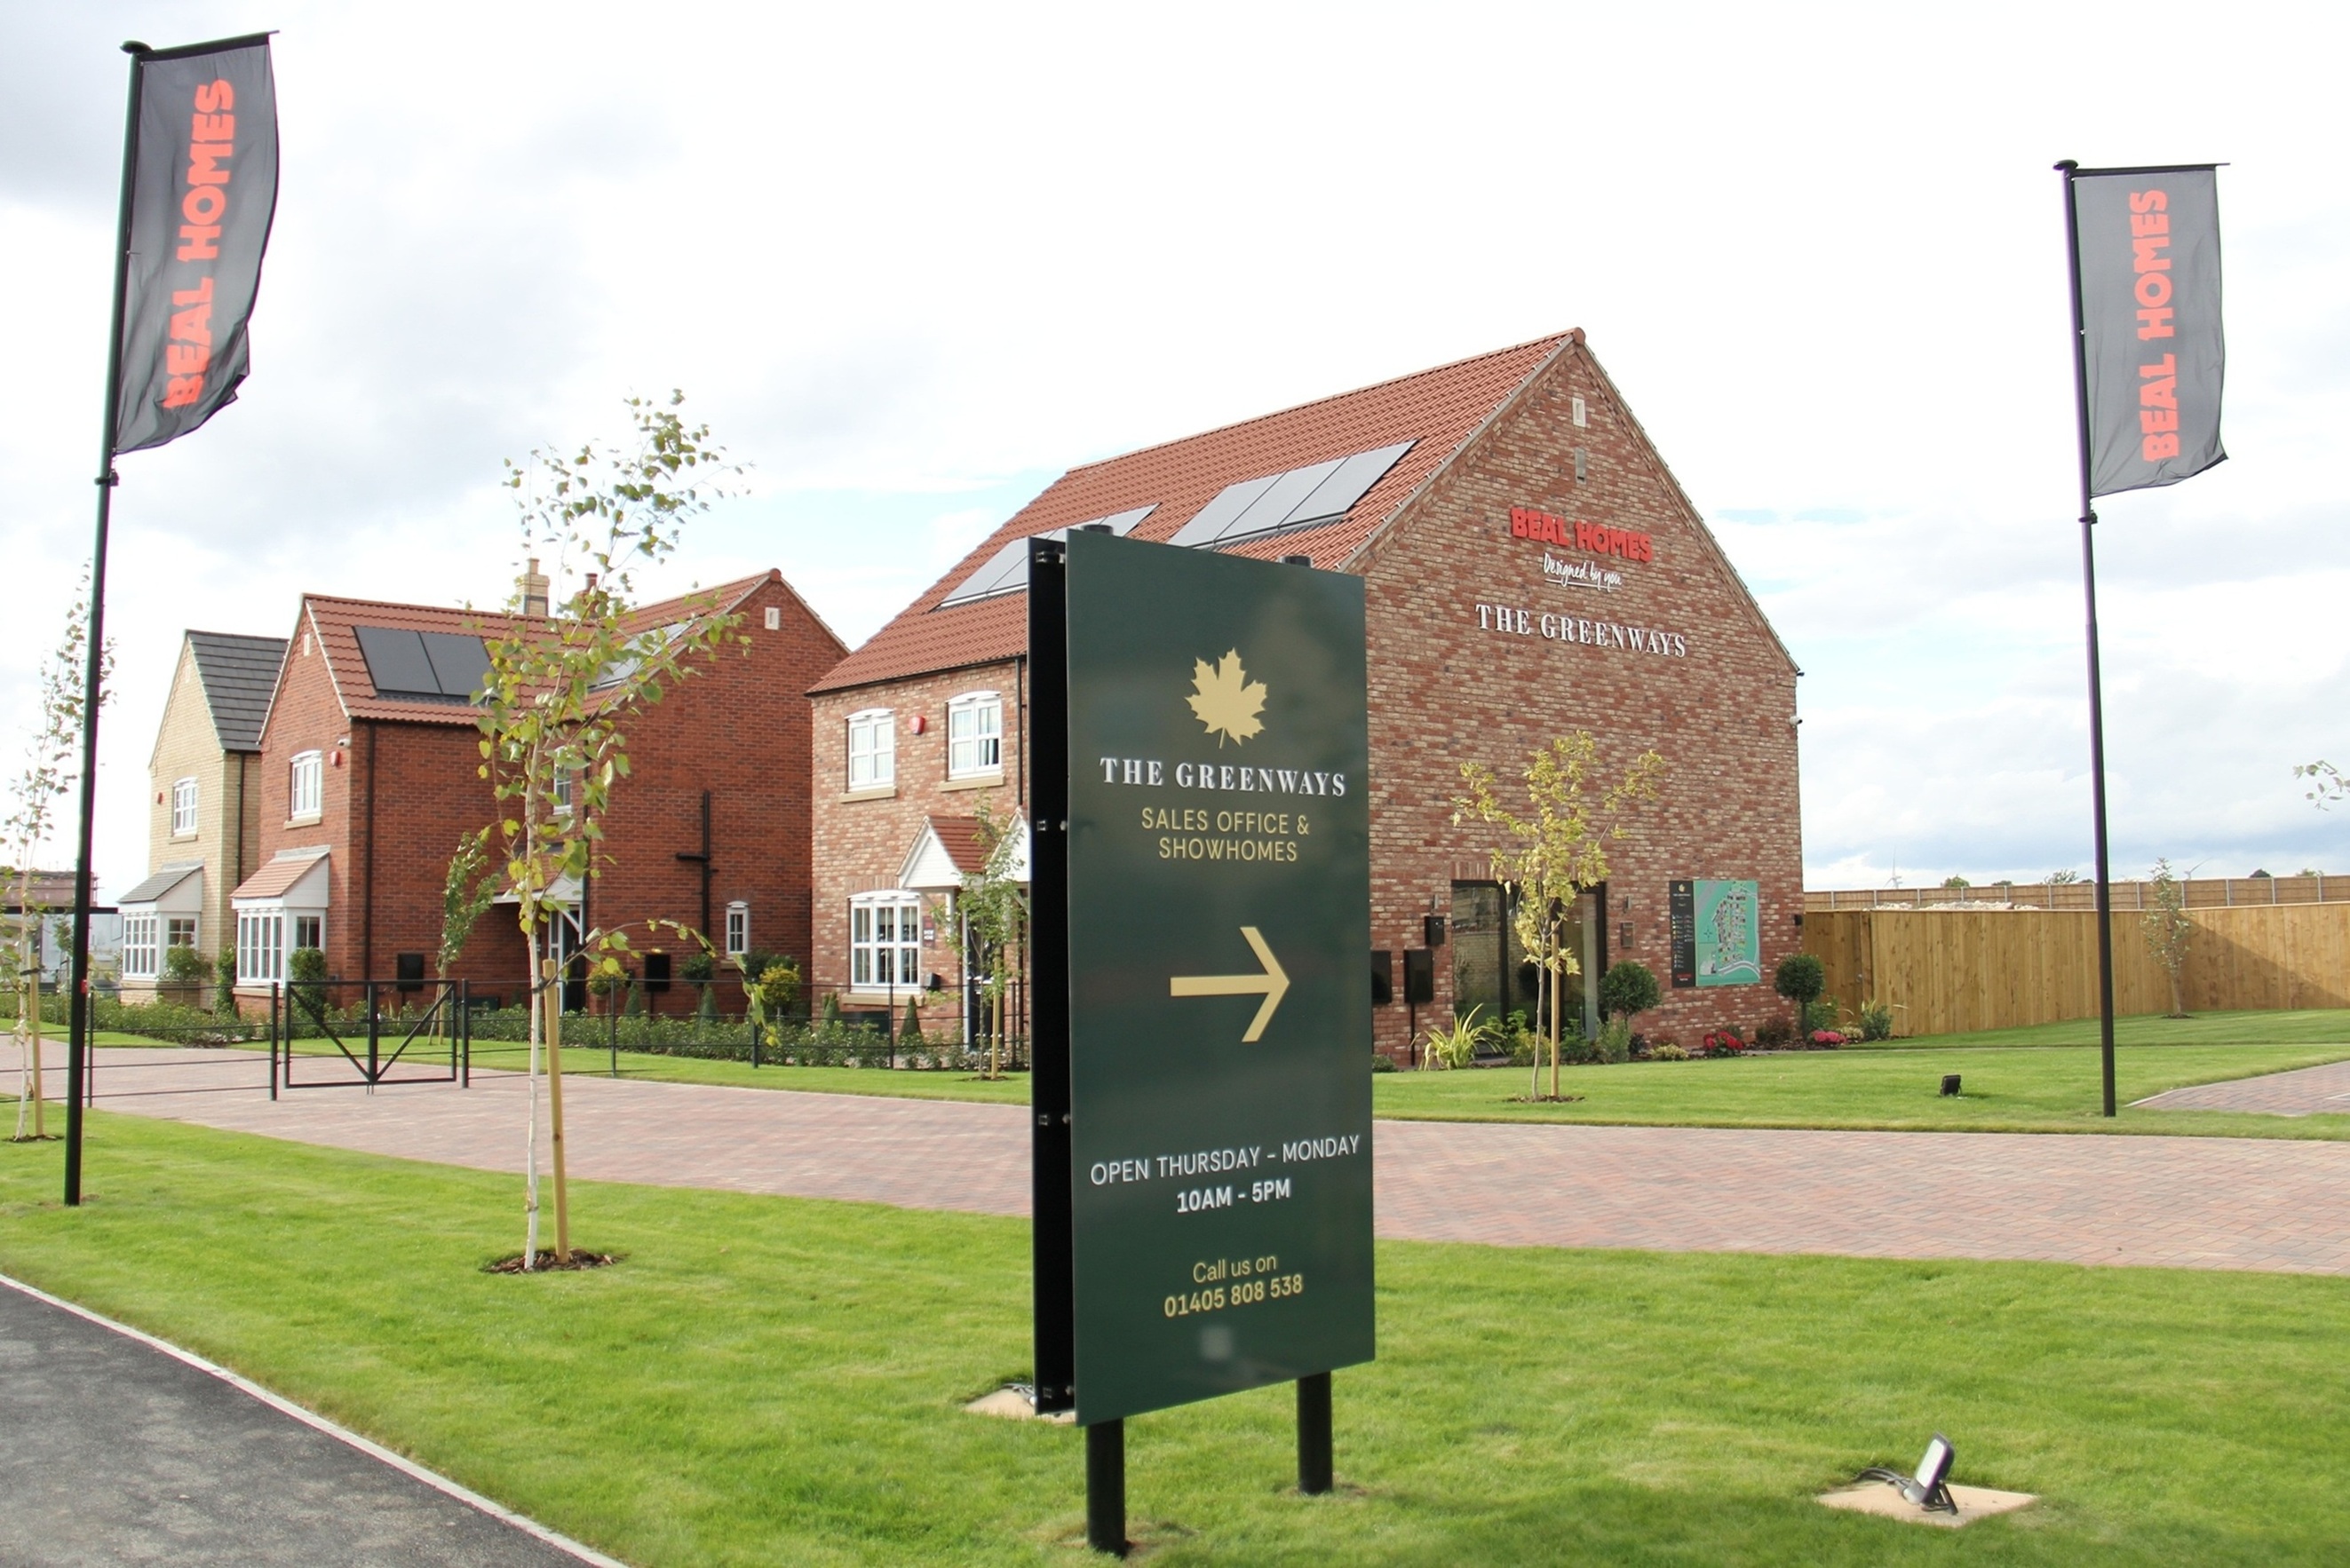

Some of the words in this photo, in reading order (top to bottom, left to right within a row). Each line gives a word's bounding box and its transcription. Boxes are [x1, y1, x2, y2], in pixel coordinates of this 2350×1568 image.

[177, 78, 236, 263] HOMES
[2129, 189, 2175, 341] HOMES
[163, 277, 216, 409] BEAL
[2138, 353, 2180, 463] BEAL
[1511, 507, 1569, 547] BEAL
[1575, 520, 1653, 563] HOMES
[1543, 552, 1588, 588] Designed
[1589, 561, 1602, 590] by
[1603, 569, 1623, 593] you
[1475, 604, 1530, 636] THE
[1540, 614, 1687, 659] GREENWAYS
[1100, 757, 1163, 787] THE
[1175, 763, 1346, 797] GREENWAYS
[1141, 806, 1208, 831] SALES
[1217, 811, 1289, 835] OFFICE
[1297, 814, 1310, 835] &
[1159, 836, 1298, 862] SHOWHOMES
[1090, 1158, 1149, 1186] OPEN
[1156, 1146, 1260, 1178] THURSDAY
[1282, 1134, 1361, 1163] MONDAY
[1177, 1186, 1232, 1213] 10AM
[1251, 1178, 1292, 1203] 5PM
[1193, 1259, 1227, 1285] Call
[1230, 1258, 1250, 1277] us
[1255, 1254, 1277, 1273] on
[1163, 1287, 1226, 1318] 01405
[1230, 1281, 1265, 1307] 808
[1270, 1273, 1304, 1298] 538
